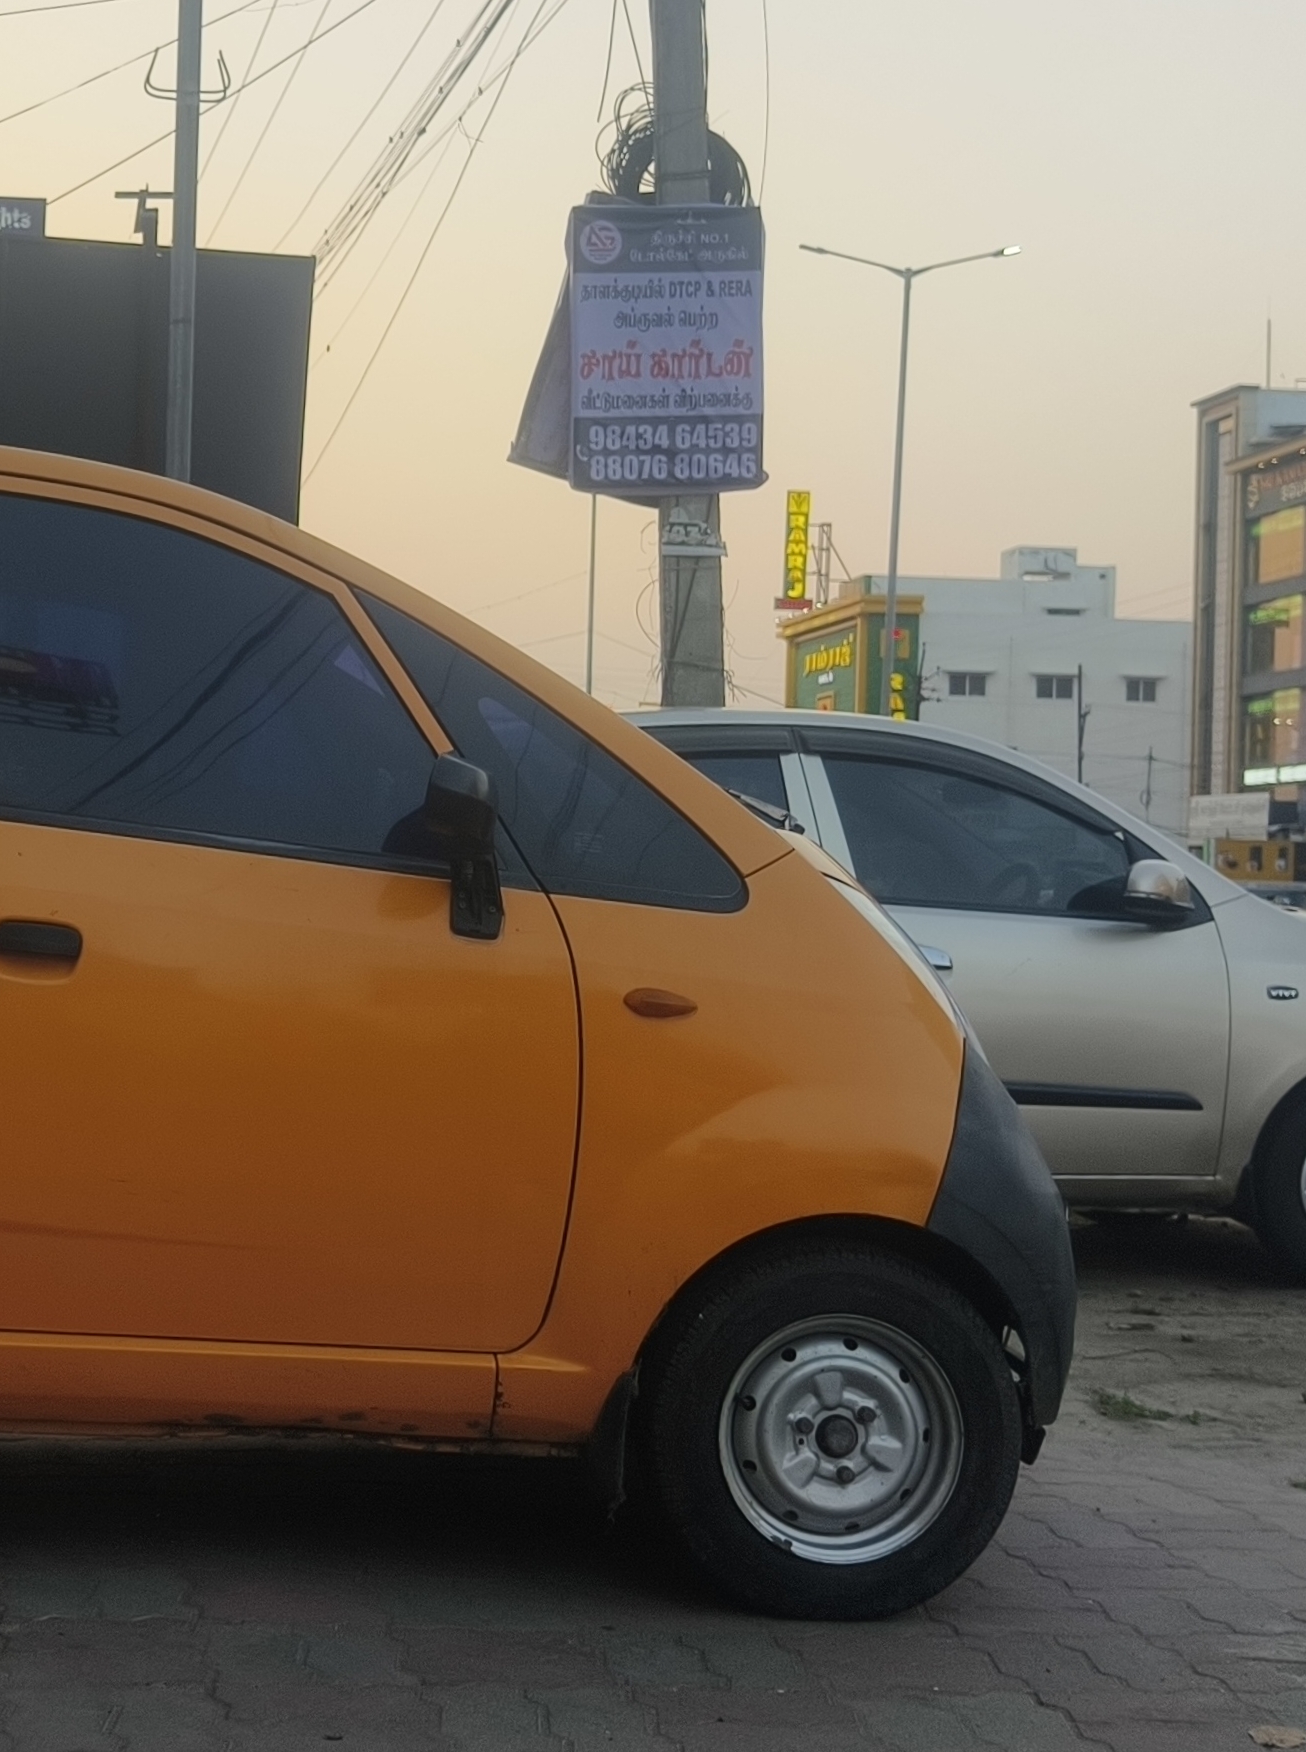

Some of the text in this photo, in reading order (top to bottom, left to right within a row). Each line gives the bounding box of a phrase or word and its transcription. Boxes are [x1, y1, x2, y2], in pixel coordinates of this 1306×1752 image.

[700, 233, 730, 244] NO.1
[669, 280, 702, 299] DTCP
[706, 280, 715, 298] &
[718, 279, 753, 298] RERA
[679, 304, 719, 332] பெற்ற
[580, 338, 754, 382] சாய் கார்டன்
[589, 422, 757, 451] 98434 64539
[590, 453, 757, 481] 88076 80646
[786, 514, 806, 598] RAMRAJ
